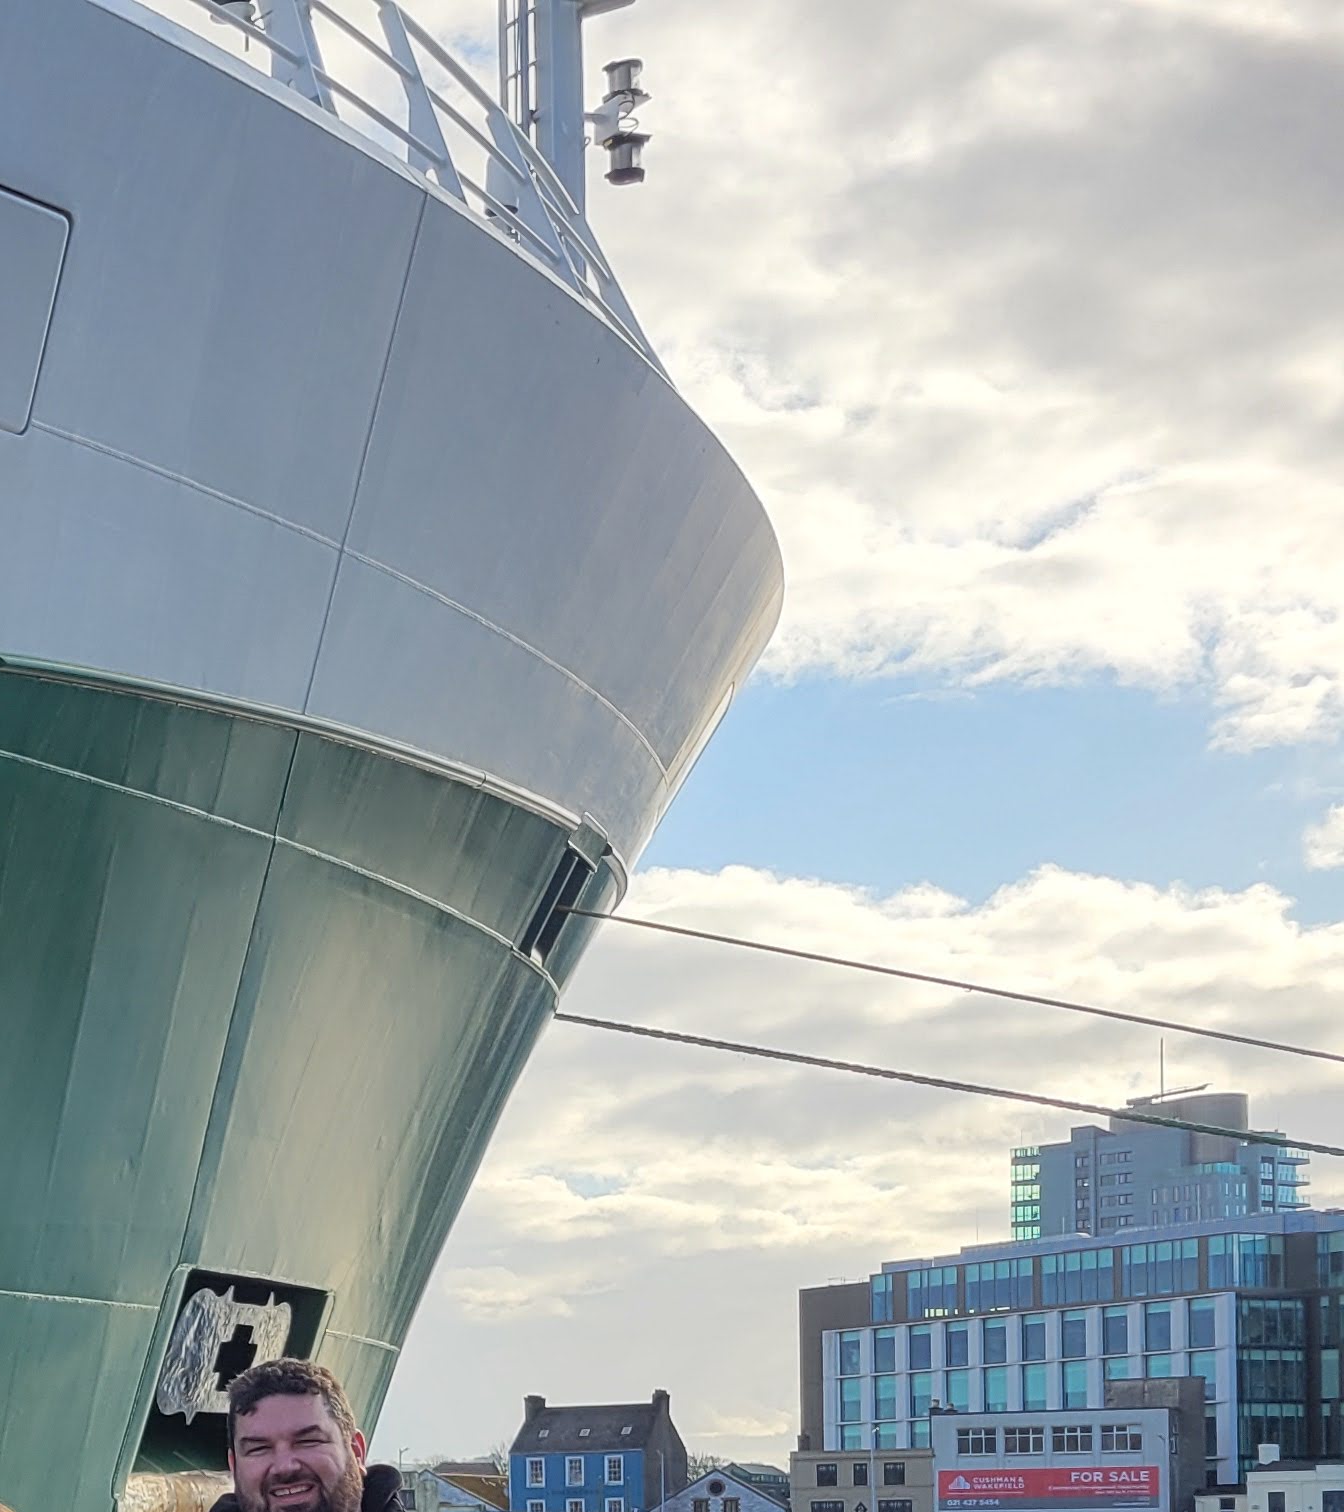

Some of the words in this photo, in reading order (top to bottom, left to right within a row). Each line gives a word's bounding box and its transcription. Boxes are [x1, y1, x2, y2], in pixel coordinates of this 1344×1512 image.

[973, 1476, 1015, 1484] CUSHMAN
[1071, 1471, 1104, 1482] FOR
[1109, 1470, 1150, 1482] SALE
